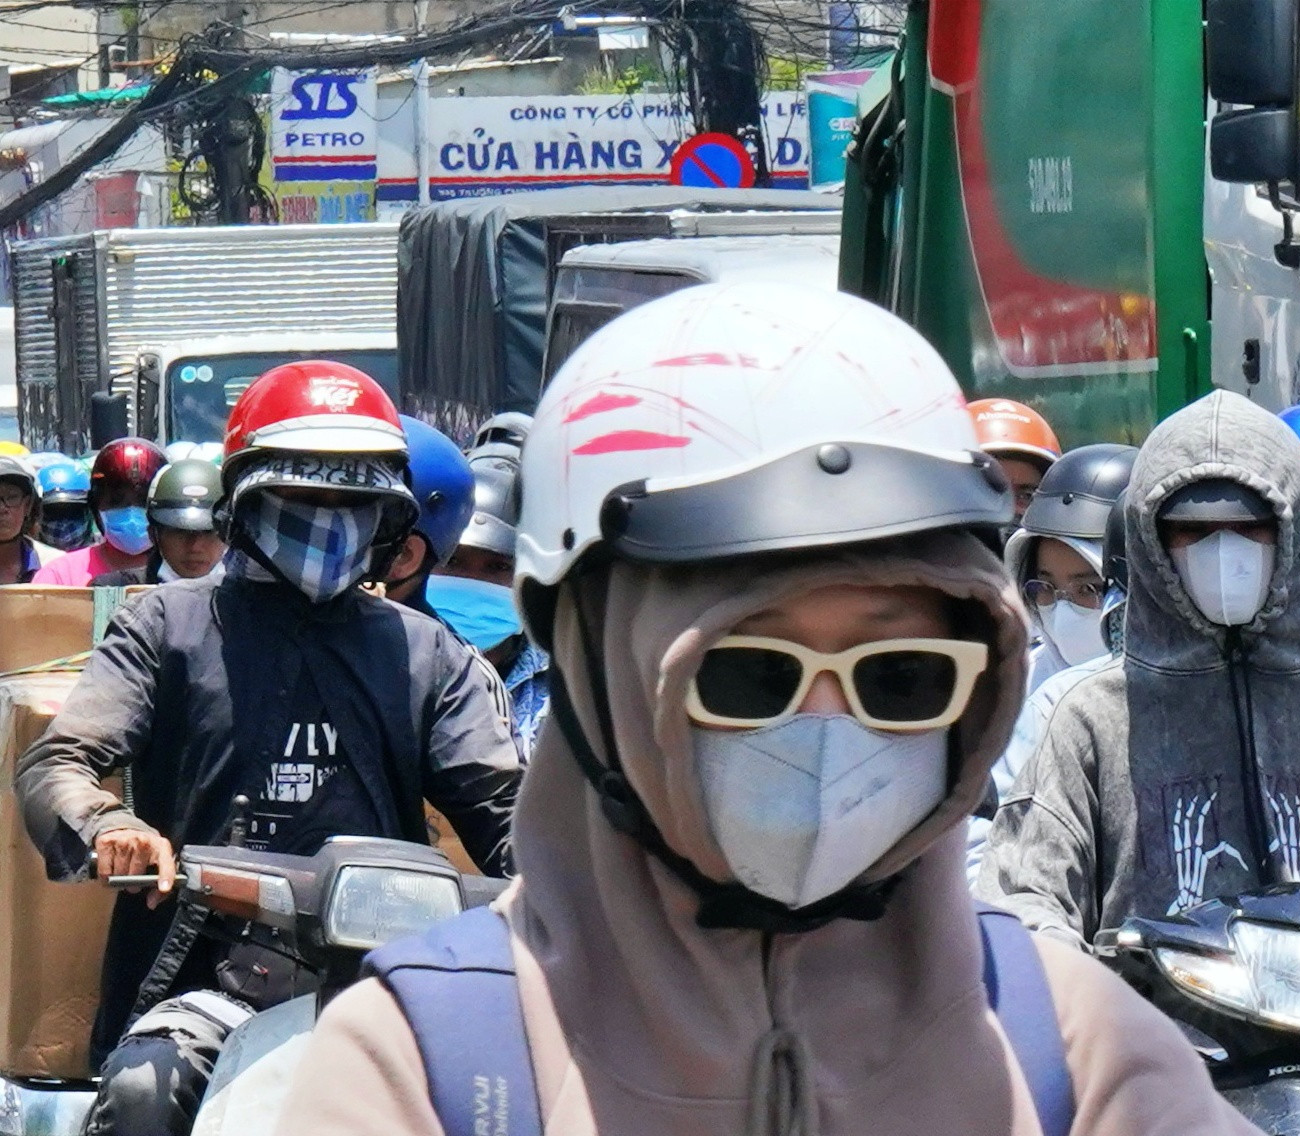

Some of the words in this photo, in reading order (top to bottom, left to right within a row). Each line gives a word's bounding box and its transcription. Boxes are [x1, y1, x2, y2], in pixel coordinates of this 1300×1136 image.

[510, 104, 567, 121] CÔNG
[573, 106, 599, 120] TY
[285, 132, 365, 148] PETRO
[440, 127, 519, 171] CỬA
[534, 131, 642, 171] HÀNG
